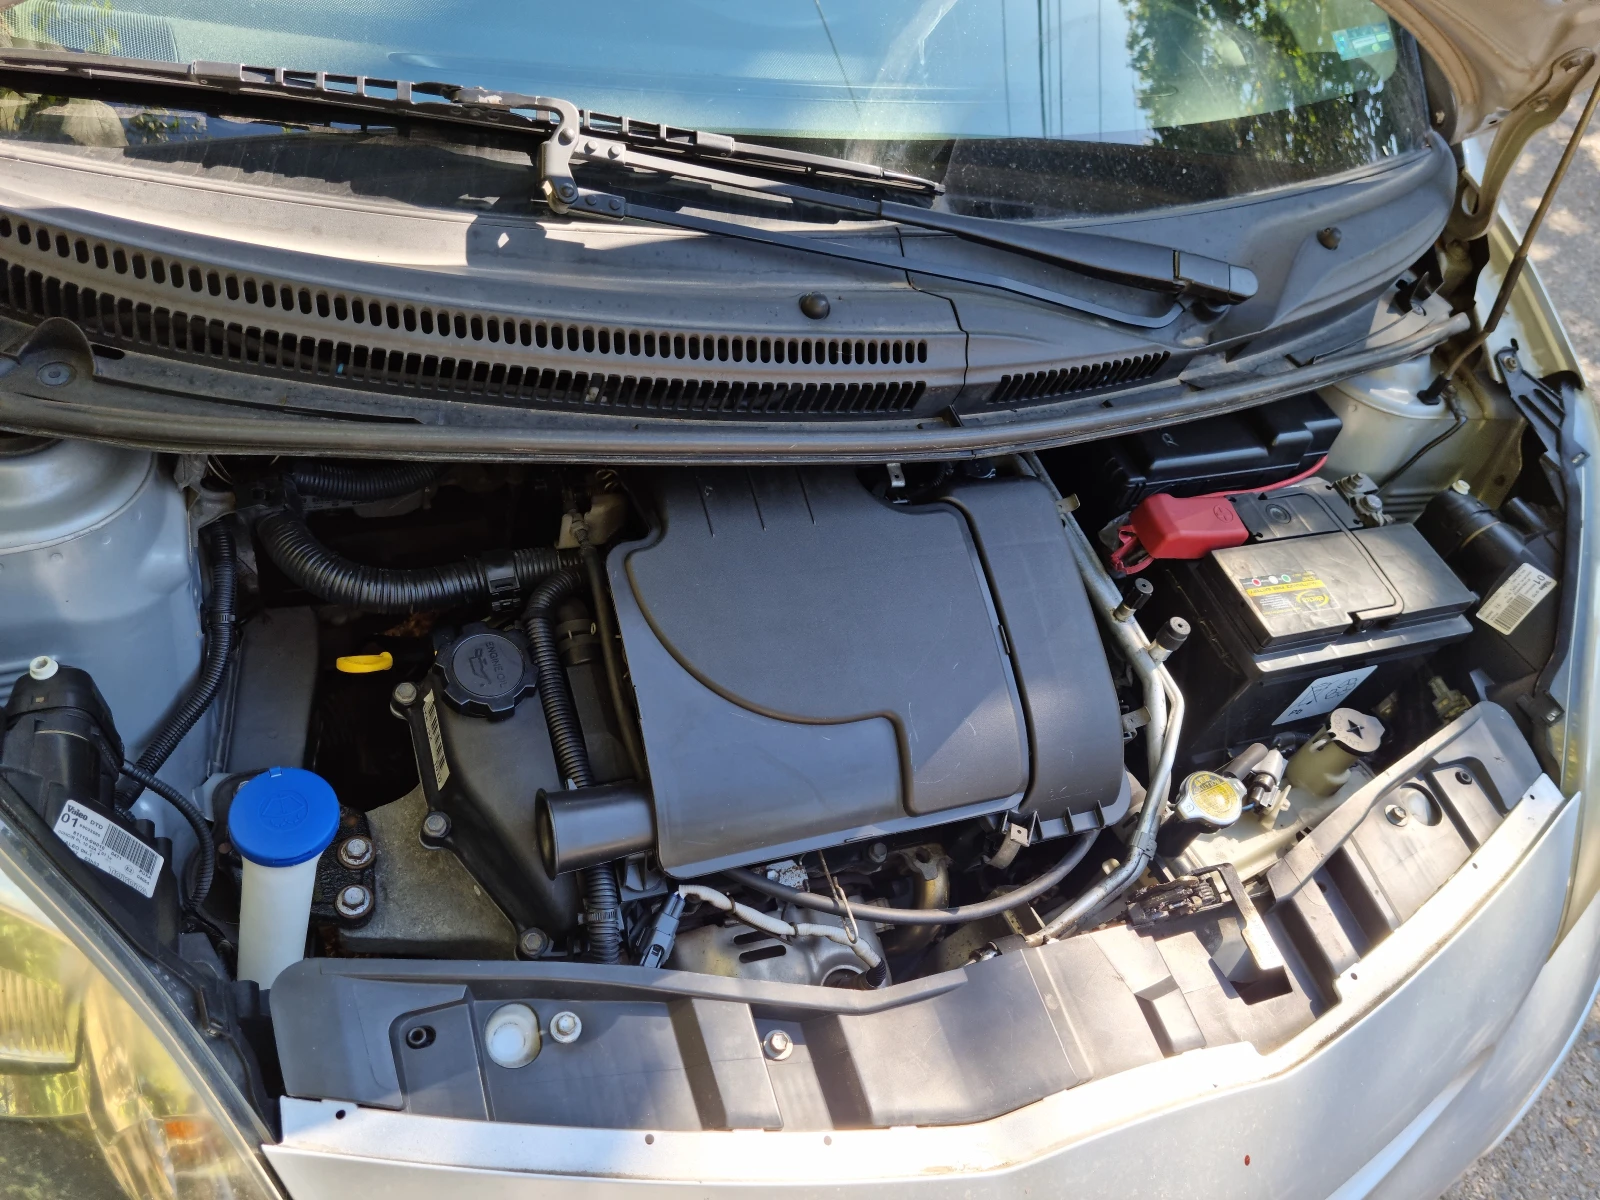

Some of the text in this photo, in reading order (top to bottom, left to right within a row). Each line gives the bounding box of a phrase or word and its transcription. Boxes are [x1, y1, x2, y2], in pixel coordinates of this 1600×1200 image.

[485, 641, 509, 688] ENGINE OIL
[1288, 708, 1303, 717] Pb
[61, 813, 78, 828] 01
[67, 804, 104, 830] Valeo DTD
